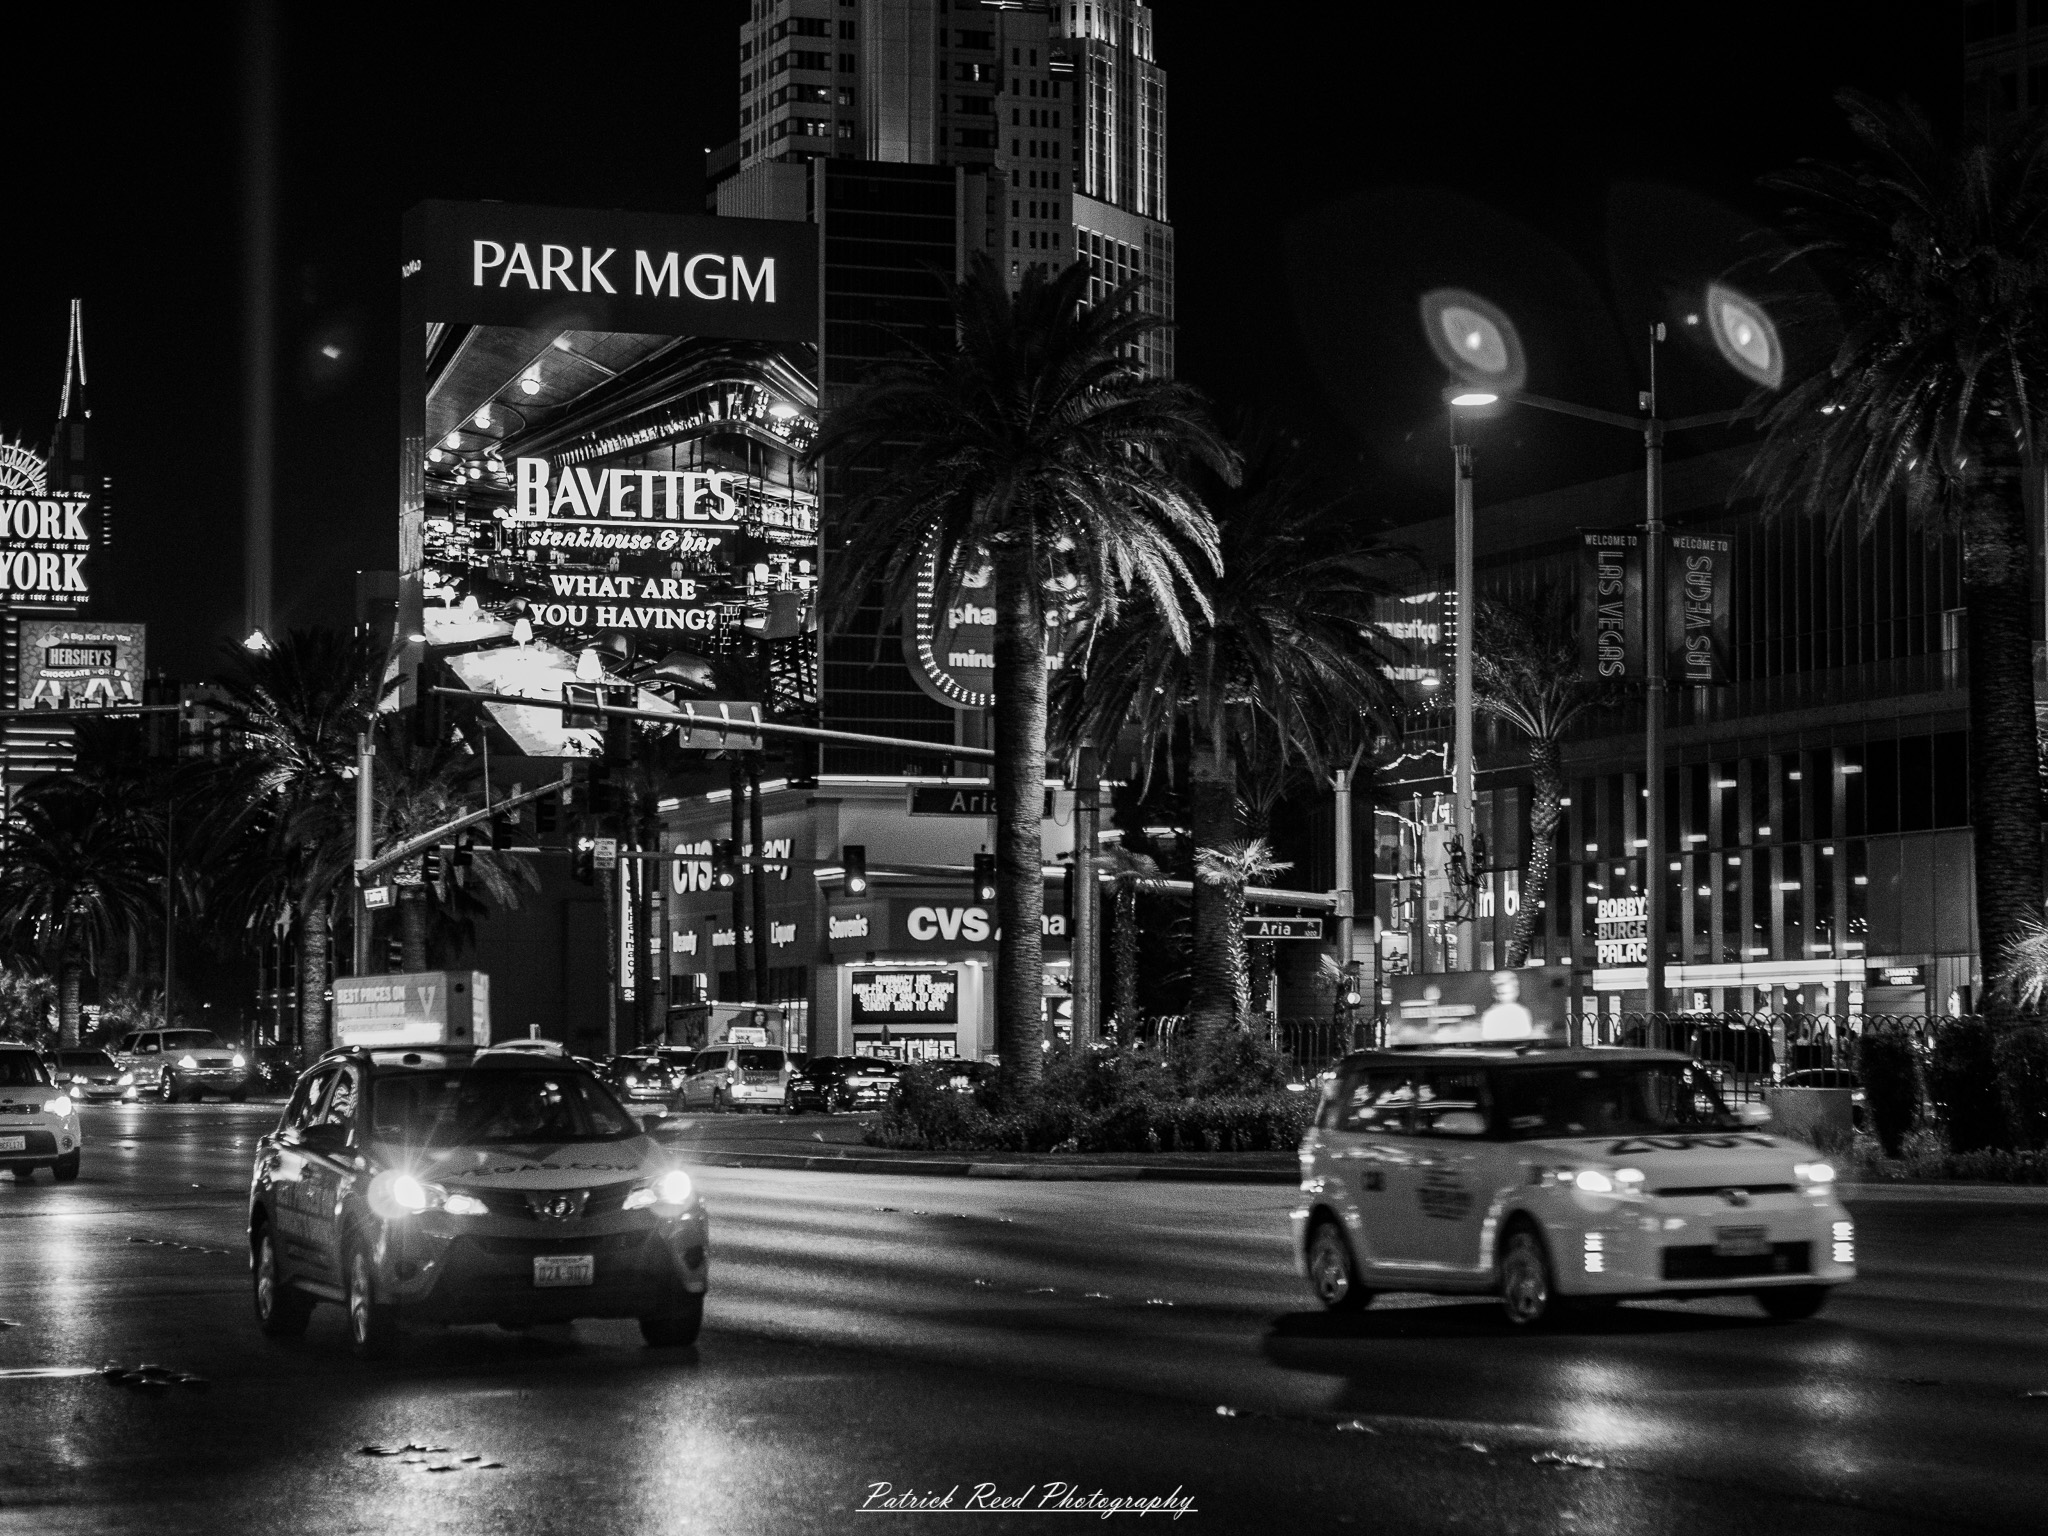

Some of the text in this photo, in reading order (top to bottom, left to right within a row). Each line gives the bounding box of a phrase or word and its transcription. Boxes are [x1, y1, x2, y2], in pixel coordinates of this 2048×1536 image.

[473, 239, 777, 303] PARK MGM
[516, 457, 738, 522] BAVETTE'S
[0, 500, 88, 540] YORK
[528, 527, 721, 553] steakhouse & bar
[1584, 534, 1638, 546] WELCOME TO
[1672, 537, 1728, 551] WELCOME TO
[0, 551, 88, 591] YORK
[550, 574, 696, 600] WHAT ARE
[531, 604, 716, 630] YOU HAVING?
[1598, 551, 1625, 676] LAS VEGAS
[1685, 555, 1712, 680] LAS VEGAS
[71, 633, 83, 641] Big
[85, 633, 100, 641] Kiss
[102, 633, 115, 641] For
[117, 634, 131, 642] You
[50, 648, 112, 666] HERSHEY'S
[40, 668, 121, 678] CHOCOLATE WORLD
[1598, 896, 1648, 918] BOBBY'
[770, 921, 797, 948] Liquor
[907, 906, 990, 941] CVS
[1259, 922, 1291, 935] Aria
[1598, 921, 1646, 939] BURGE
[1598, 943, 1648, 963] PALAC
[876, 975, 914, 986] PHARMACY
[860, 992, 897, 1003] SATURDAY
[862, 1001, 891, 1011] SUNDAY
